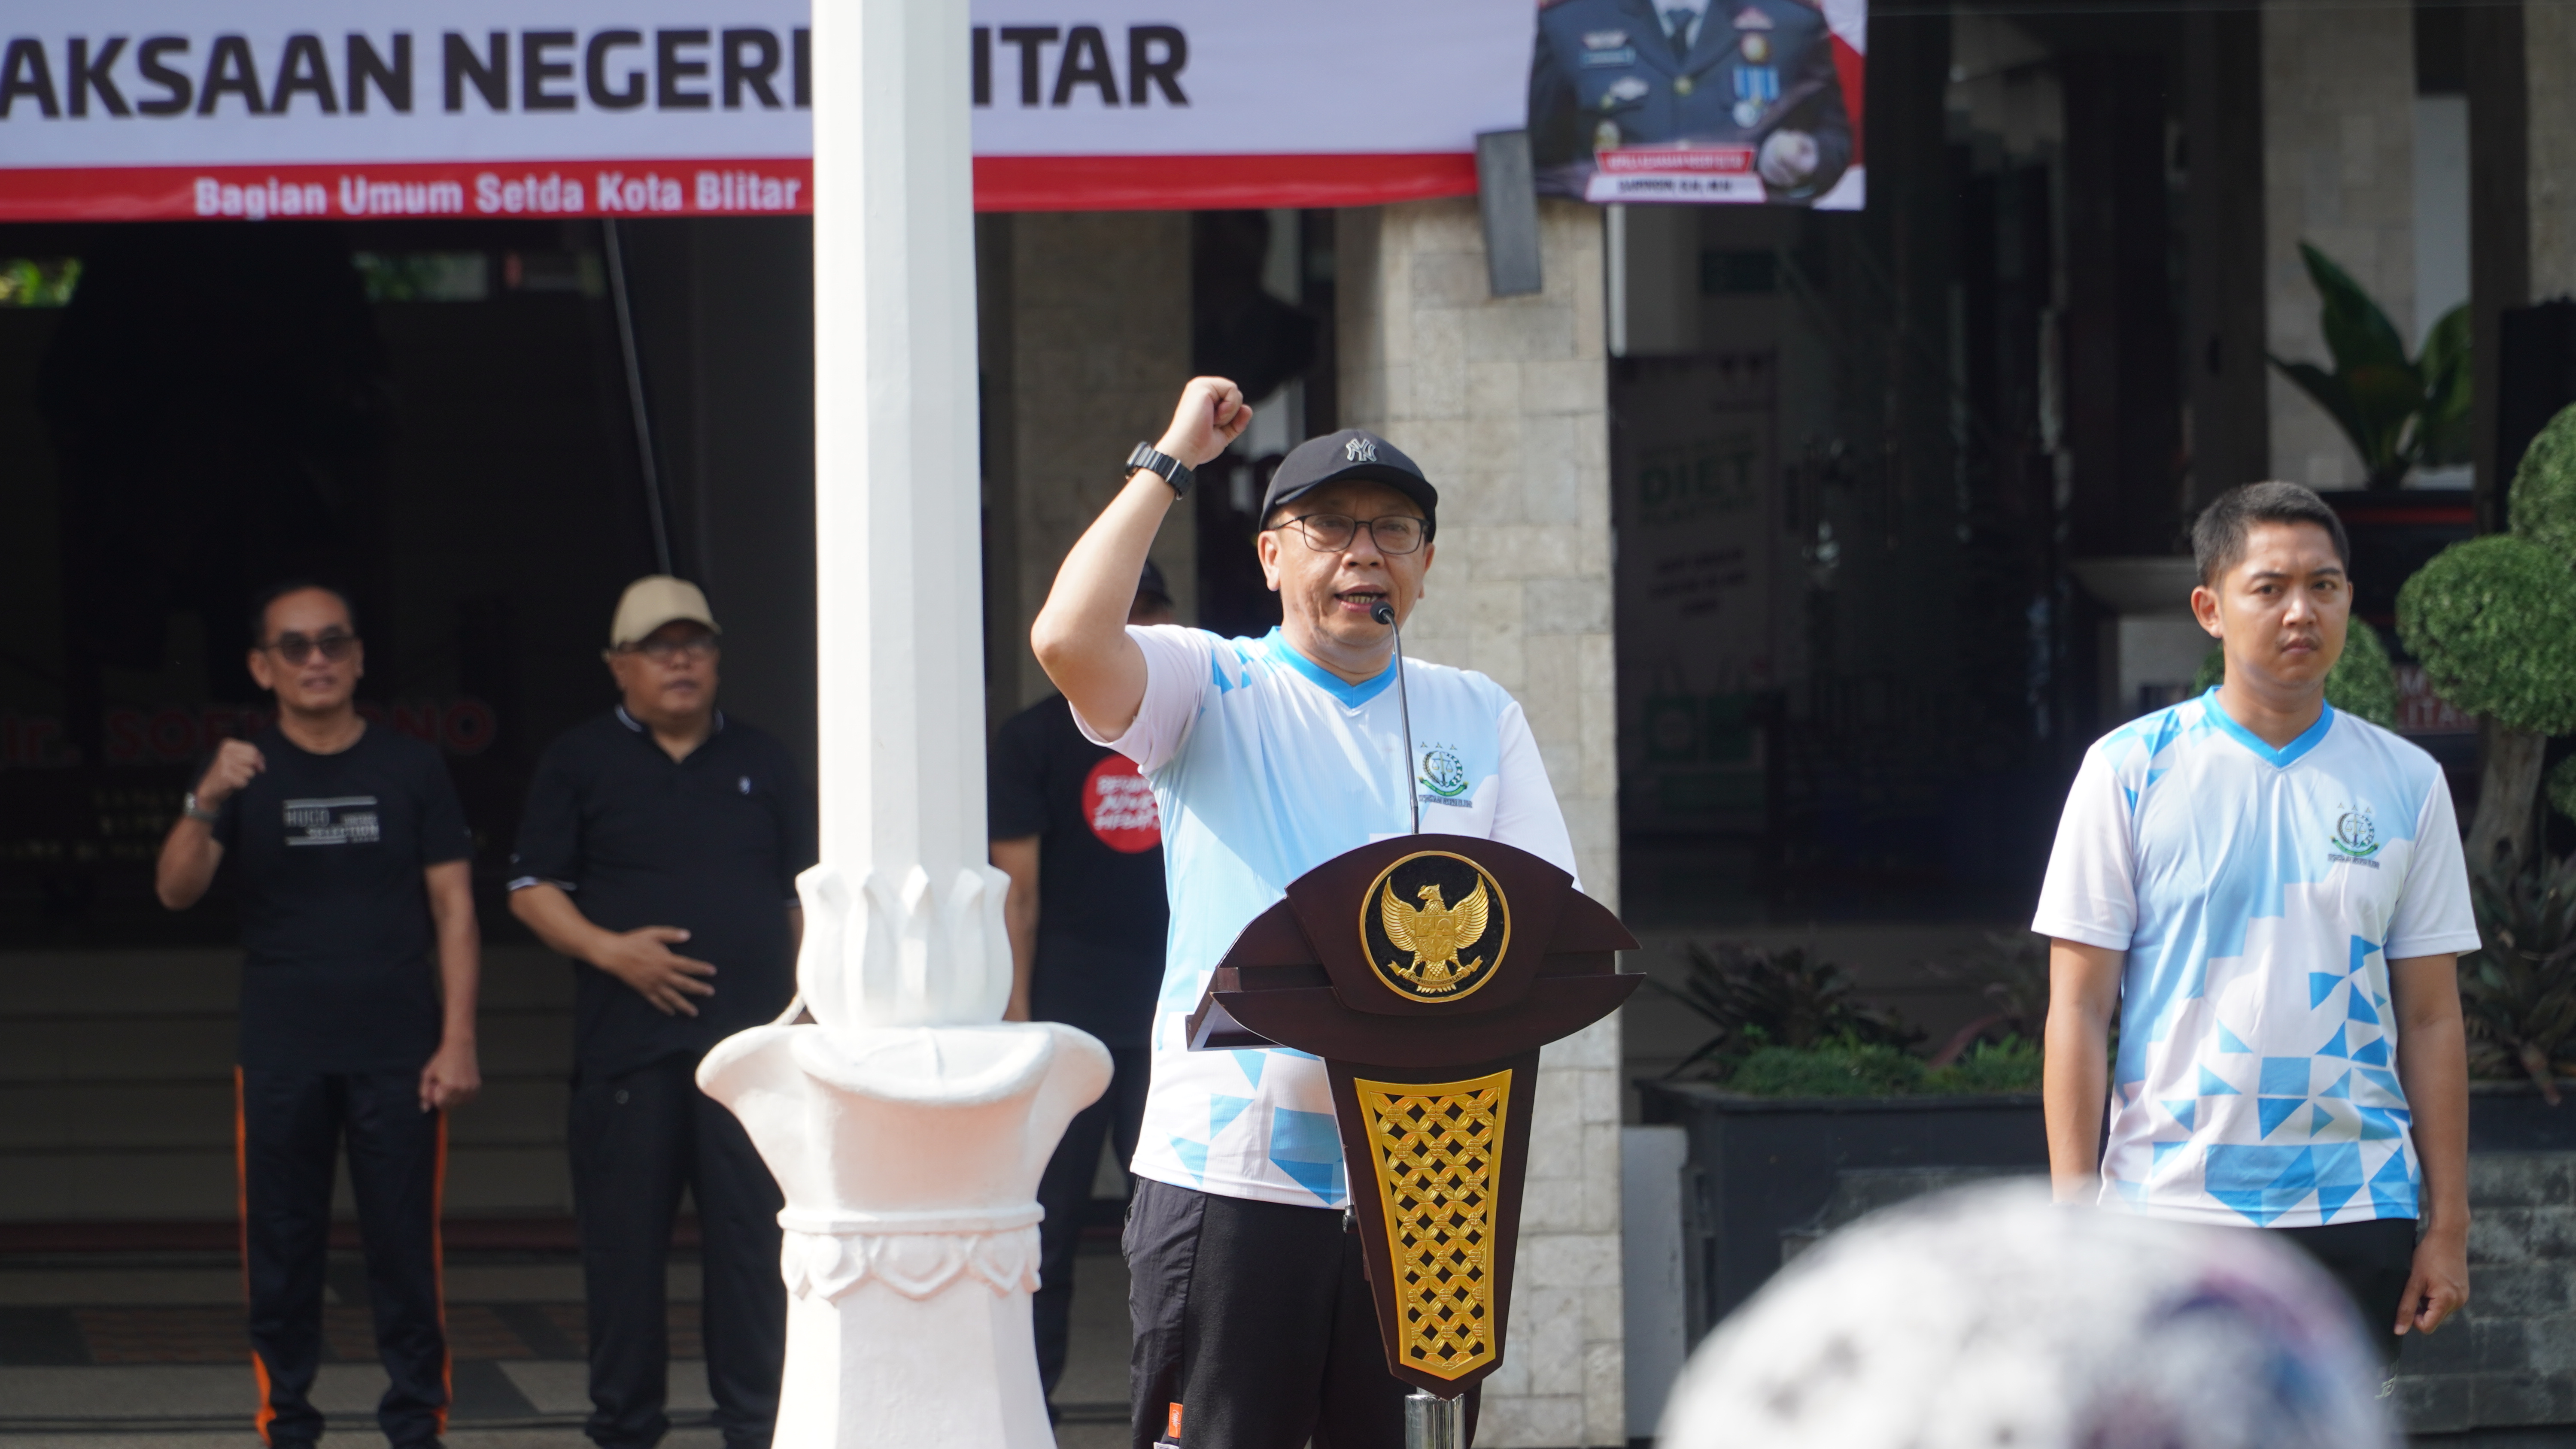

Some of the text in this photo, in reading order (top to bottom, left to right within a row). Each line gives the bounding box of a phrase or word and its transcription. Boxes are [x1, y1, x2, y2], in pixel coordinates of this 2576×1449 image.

[442, 27, 811, 112] NEGERI
[971, 24, 1189, 107] ITAR
[193, 171, 802, 219] Bagian Umum Setda Kota Blitar
[283, 809, 330, 828] HUGO
